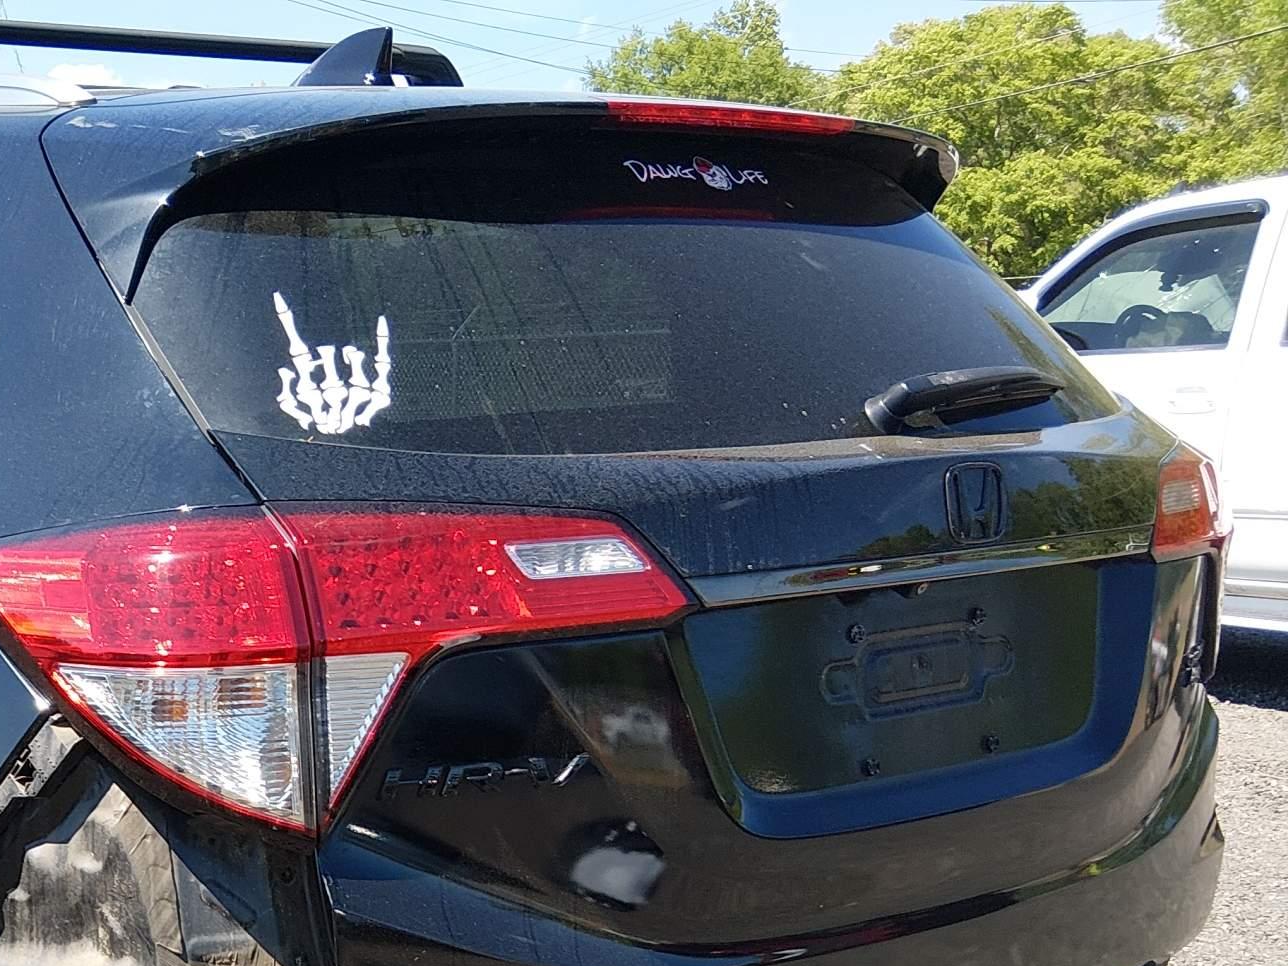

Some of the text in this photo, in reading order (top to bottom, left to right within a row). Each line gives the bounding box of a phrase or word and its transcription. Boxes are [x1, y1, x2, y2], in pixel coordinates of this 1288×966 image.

[623, 160, 769, 185] DAWG LIFE
[380, 751, 590, 797] HR-V
